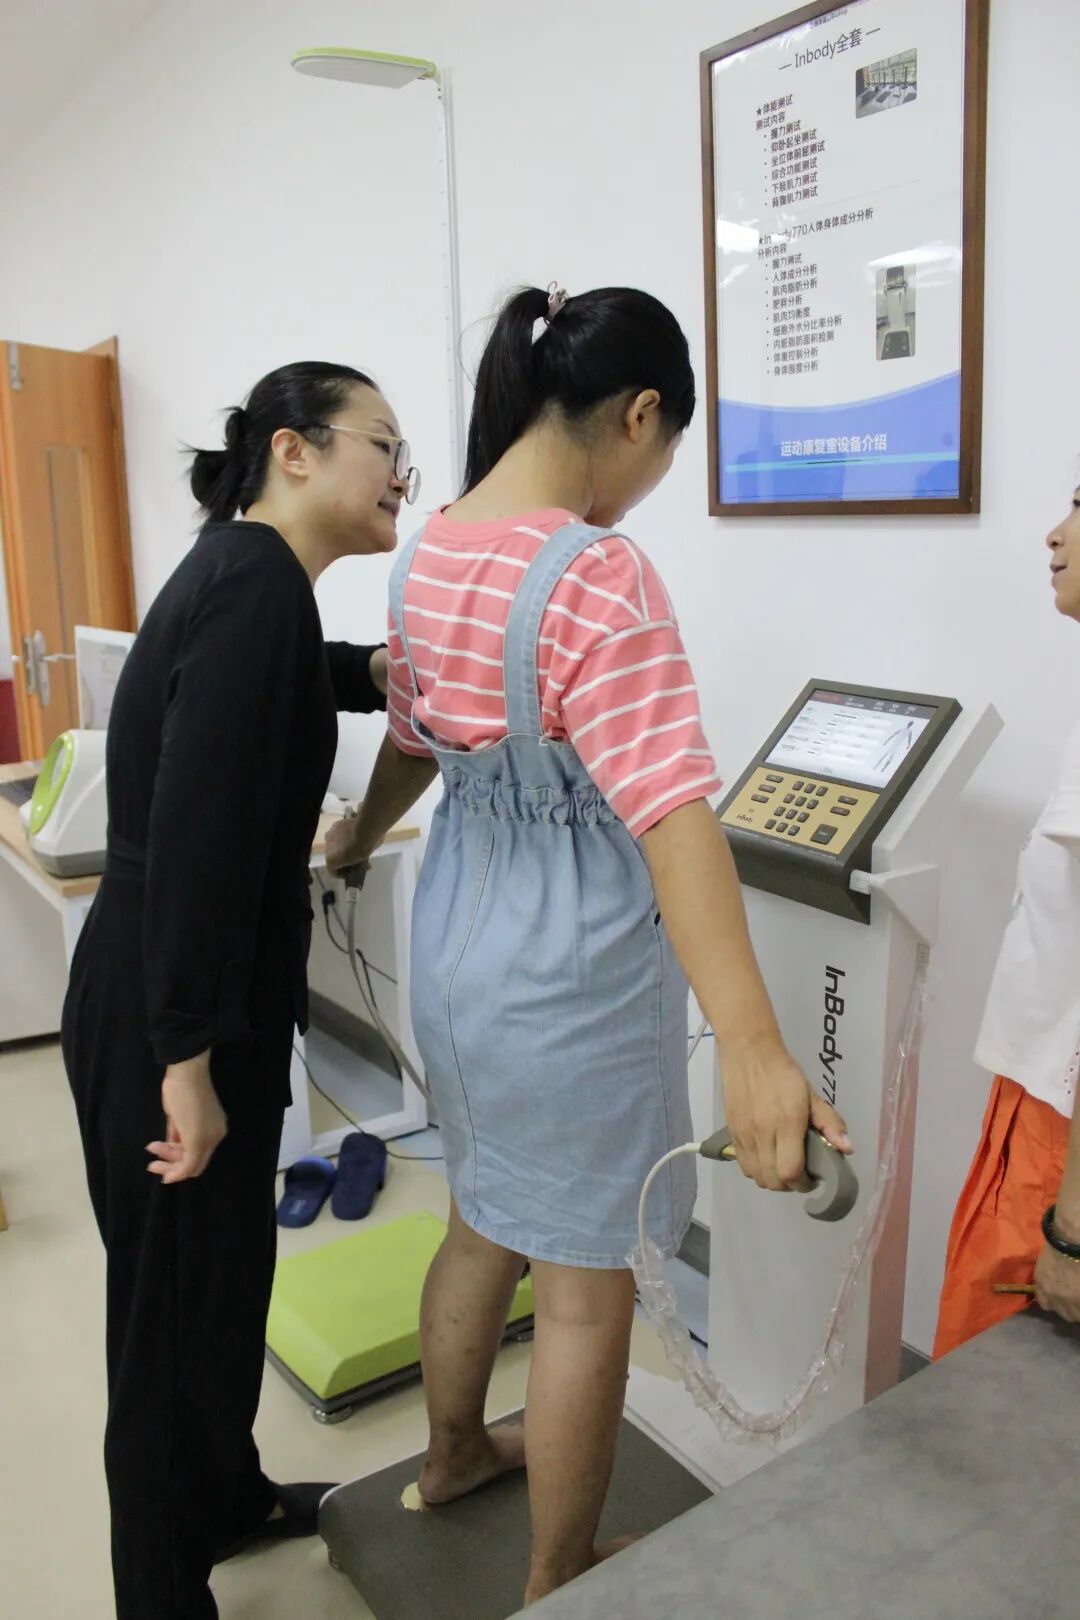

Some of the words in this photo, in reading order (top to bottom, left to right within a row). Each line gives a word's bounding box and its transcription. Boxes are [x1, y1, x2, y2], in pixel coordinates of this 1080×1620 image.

[795, 27, 862, 68] Inbody全套
[763, 94, 793, 115] 体能测试
[756, 111, 786, 131] 测试内容
[771, 120, 801, 140] 握力测试
[771, 128, 817, 153] 仰卧起坐测试
[771, 140, 825, 167] 坐位体前屈测试
[771, 157, 818, 181] 综合功能测试
[772, 171, 818, 195] 下肢肌力测试
[758, 243, 787, 259] 分析内容
[772, 252, 802, 270] 握力测试
[772, 264, 817, 283] 人体成分分析
[772, 277, 817, 297] 肌肉脂肪分析
[773, 294, 802, 310] 肥胖分析
[773, 306, 810, 323] 肌肉均衡度
[773, 315, 842, 336] 细胞外水分比率分析
[773, 346, 818, 362] 体重控制分析
[774, 360, 818, 376] 身体围度分析
[781, 432, 887, 457] 运动康复室设备介绍
[819, 965, 845, 1108] InBody77
